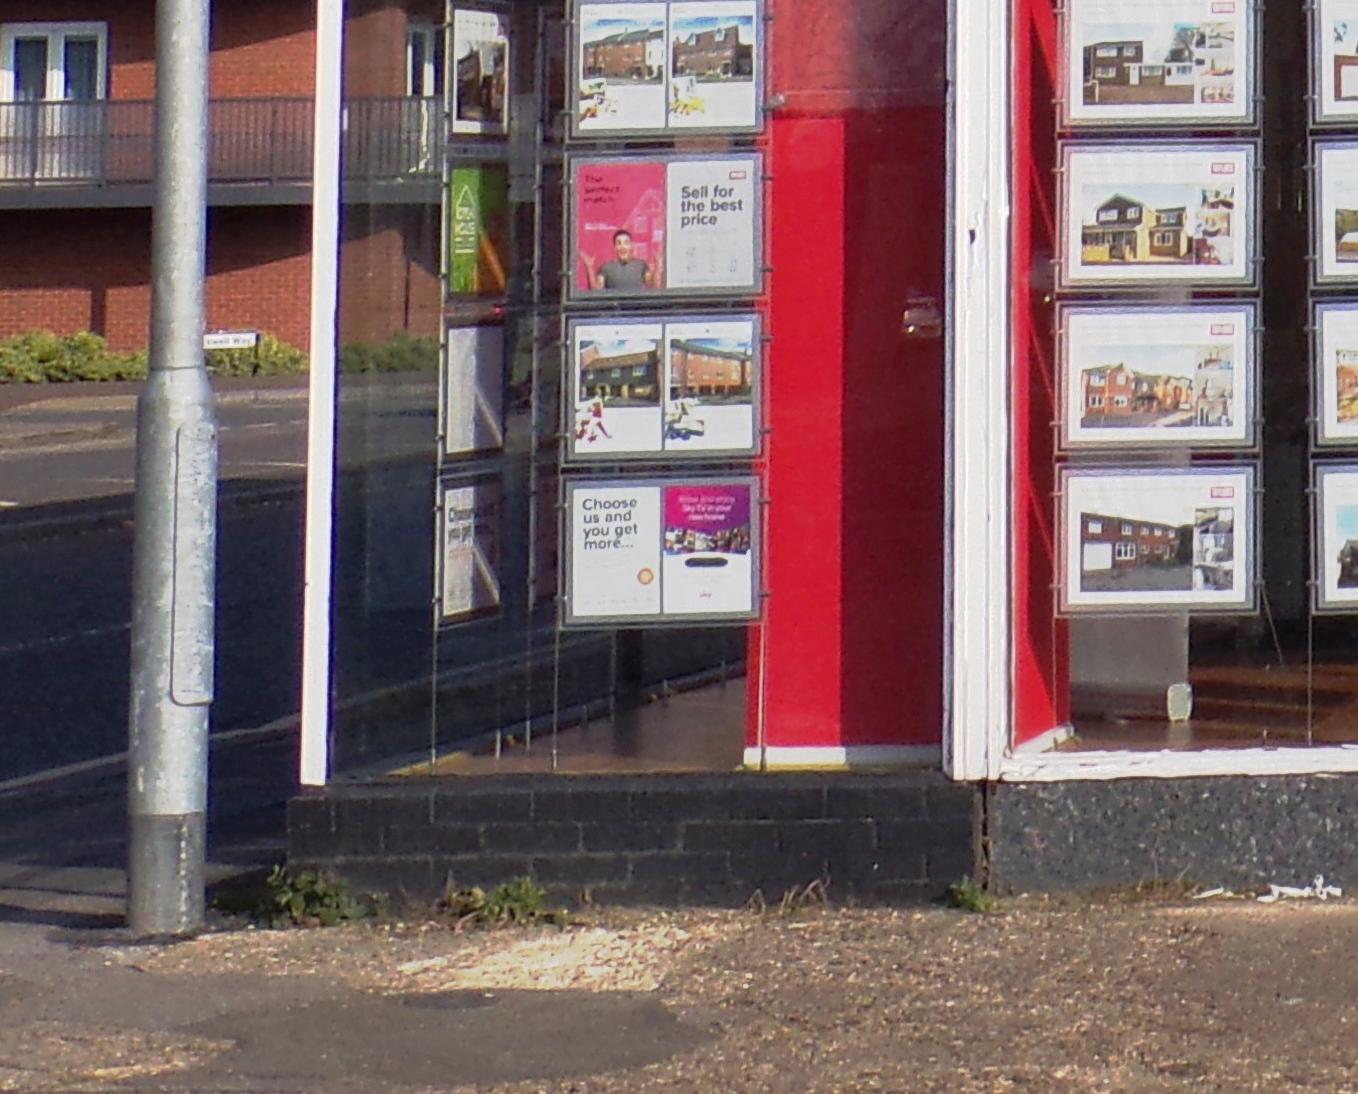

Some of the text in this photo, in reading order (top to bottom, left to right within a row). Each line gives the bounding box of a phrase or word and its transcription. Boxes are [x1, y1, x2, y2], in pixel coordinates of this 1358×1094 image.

[681, 184, 734, 199] Sell for
[681, 199, 743, 212] the best
[681, 212, 718, 229] price
[582, 498, 638, 511] Choose
[583, 510, 632, 524] us and
[583, 523, 638, 540] you get
